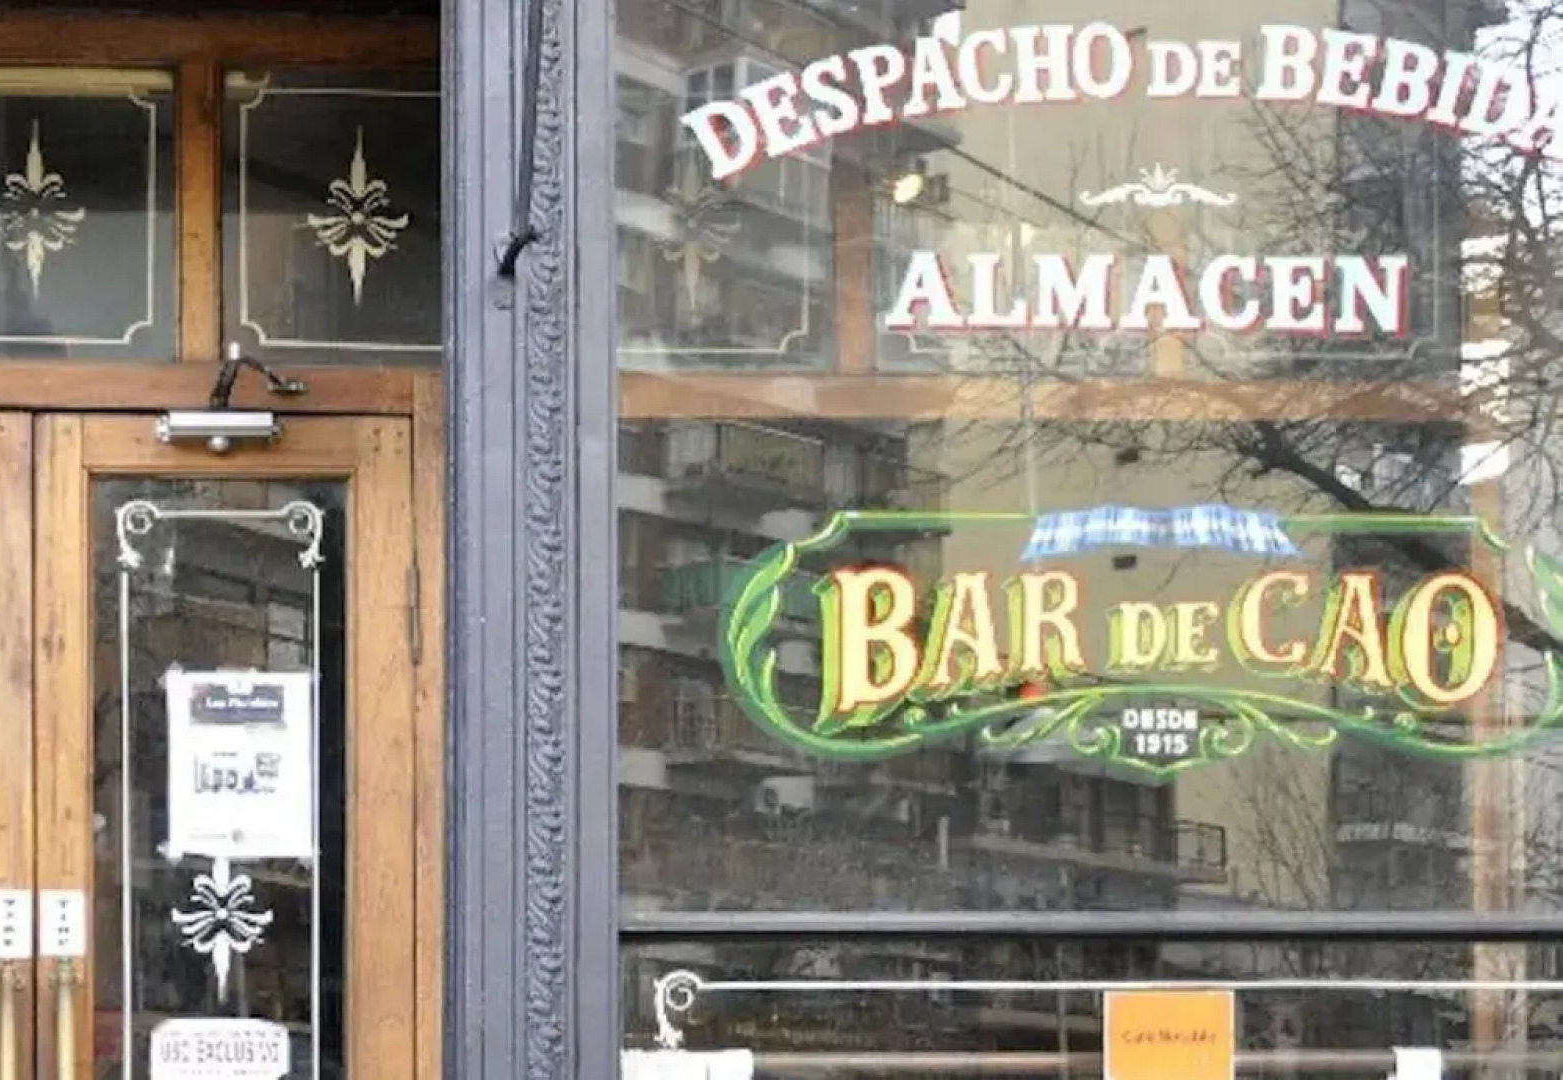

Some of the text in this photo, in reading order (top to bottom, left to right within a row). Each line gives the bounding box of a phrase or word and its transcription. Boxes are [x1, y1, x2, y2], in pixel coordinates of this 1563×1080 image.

[679, 21, 1133, 183] DESPACHO
[1146, 41, 1240, 98] DE
[884, 250, 1411, 336] ALMACEN
[814, 564, 1505, 730] BAR DE CAO
[1122, 708, 1199, 731] DESDE
[1135, 733, 1189, 756] 1915
